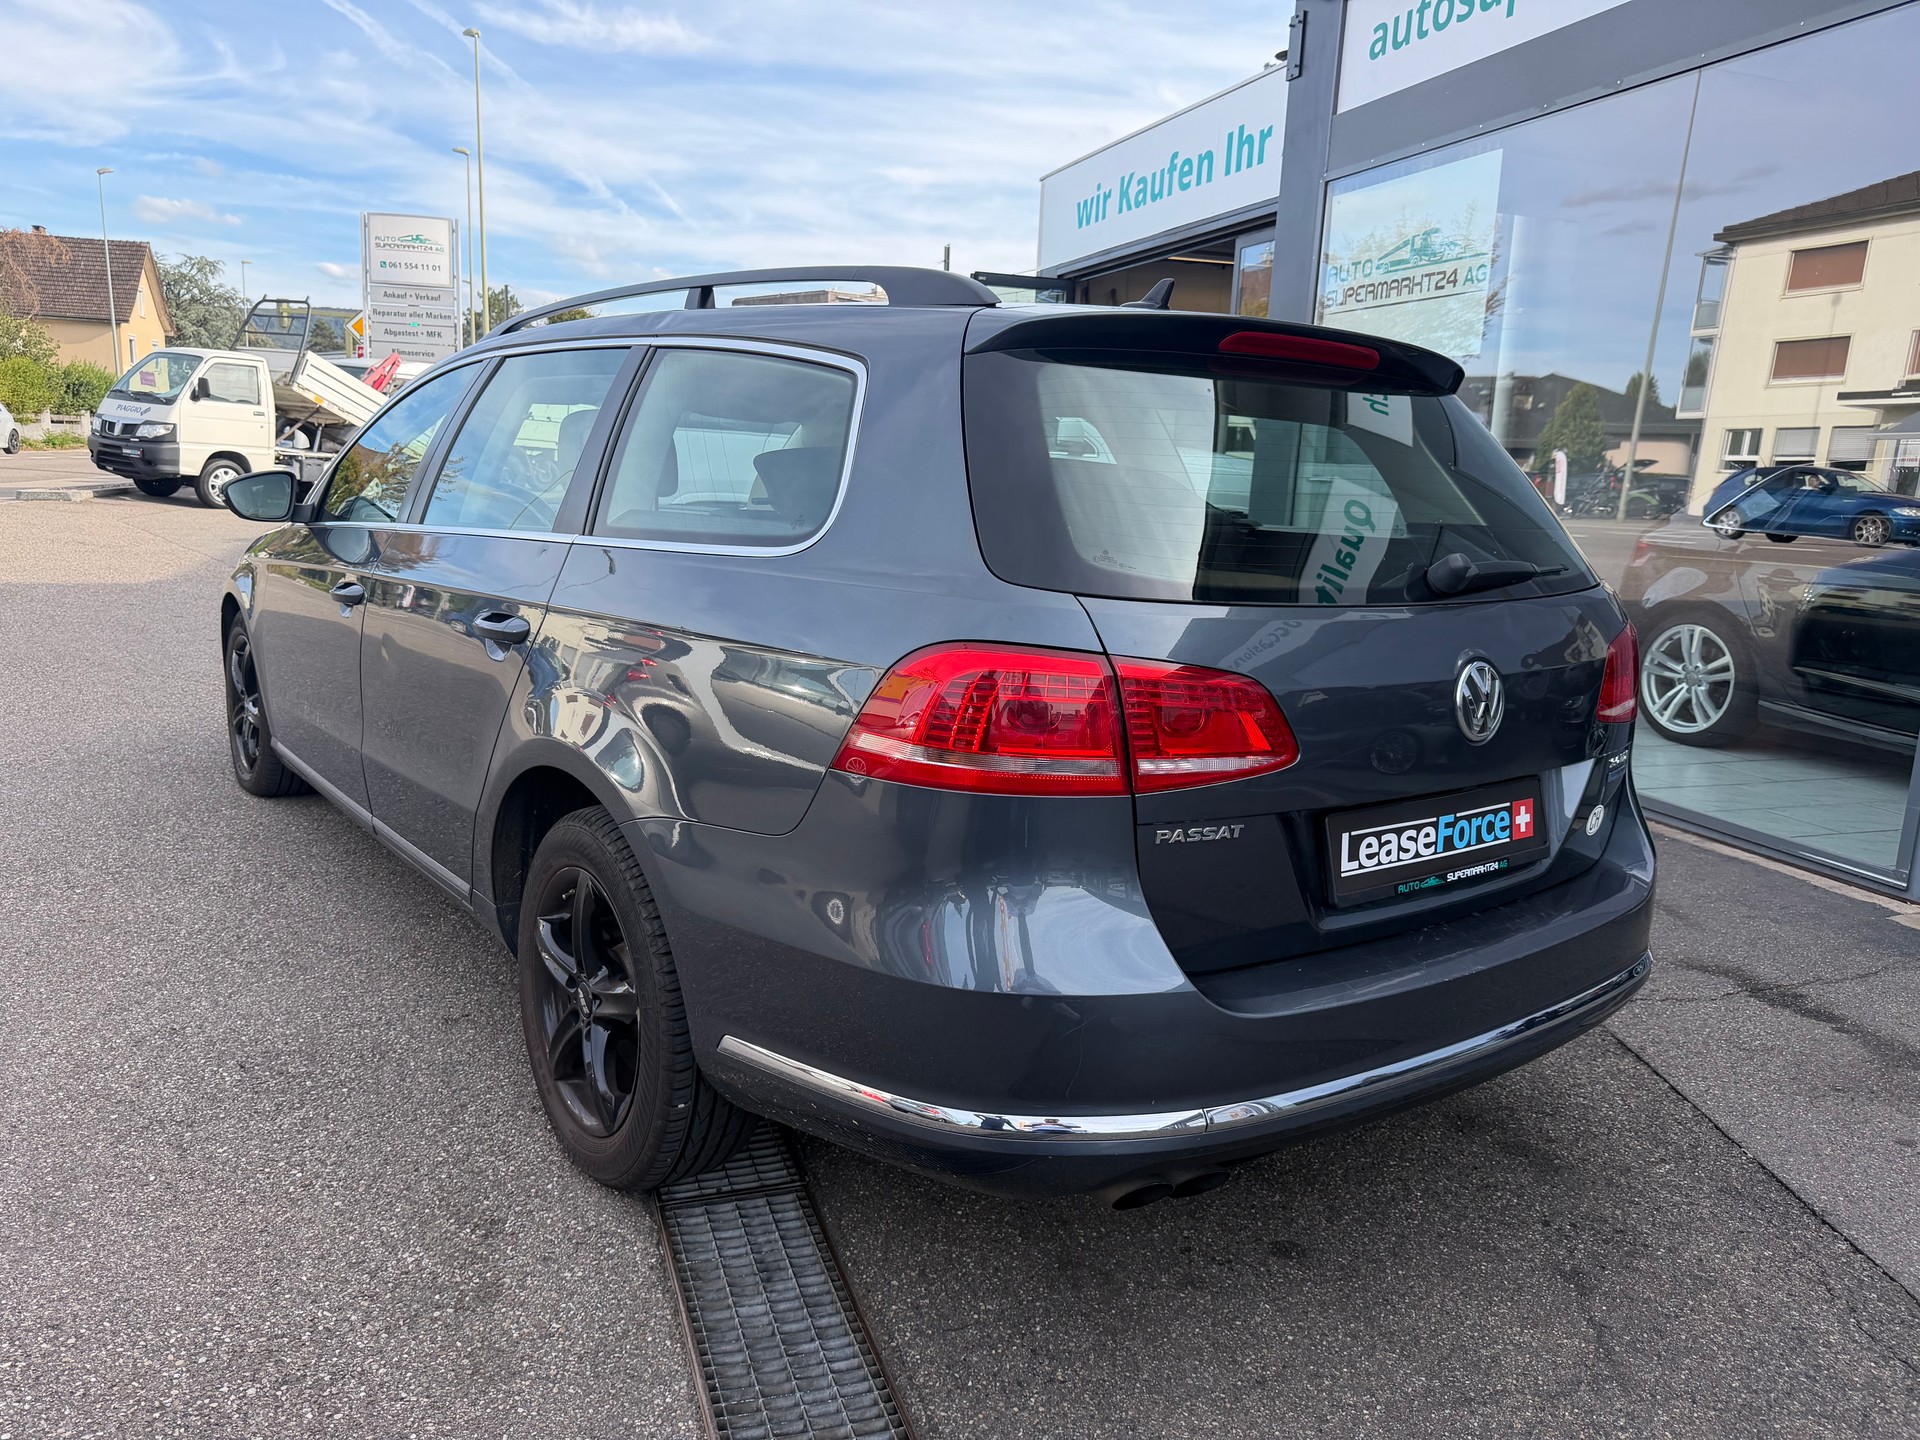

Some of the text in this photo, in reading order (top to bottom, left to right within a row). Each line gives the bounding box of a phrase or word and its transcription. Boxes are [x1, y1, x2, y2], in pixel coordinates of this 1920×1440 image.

[1076, 123, 1274, 229] wir Kaufen Ihr
[388, 261, 441, 272] 061 554 11 01
[1327, 258, 1374, 284] AUTO
[1462, 264, 1489, 286] AG
[383, 290, 407, 299] Ankauf
[414, 292, 441, 302] Verkauf
[372, 308, 407, 317] Reparatur
[426, 311, 452, 320] Marken
[384, 328, 419, 337] Abgastest
[426, 330, 443, 339] MFK
[1155, 824, 1245, 845] PASSAT
[1341, 810, 1511, 872] LeaseForce
[1397, 881, 1420, 894] AUTO
[1499, 859, 1508, 868] AG
